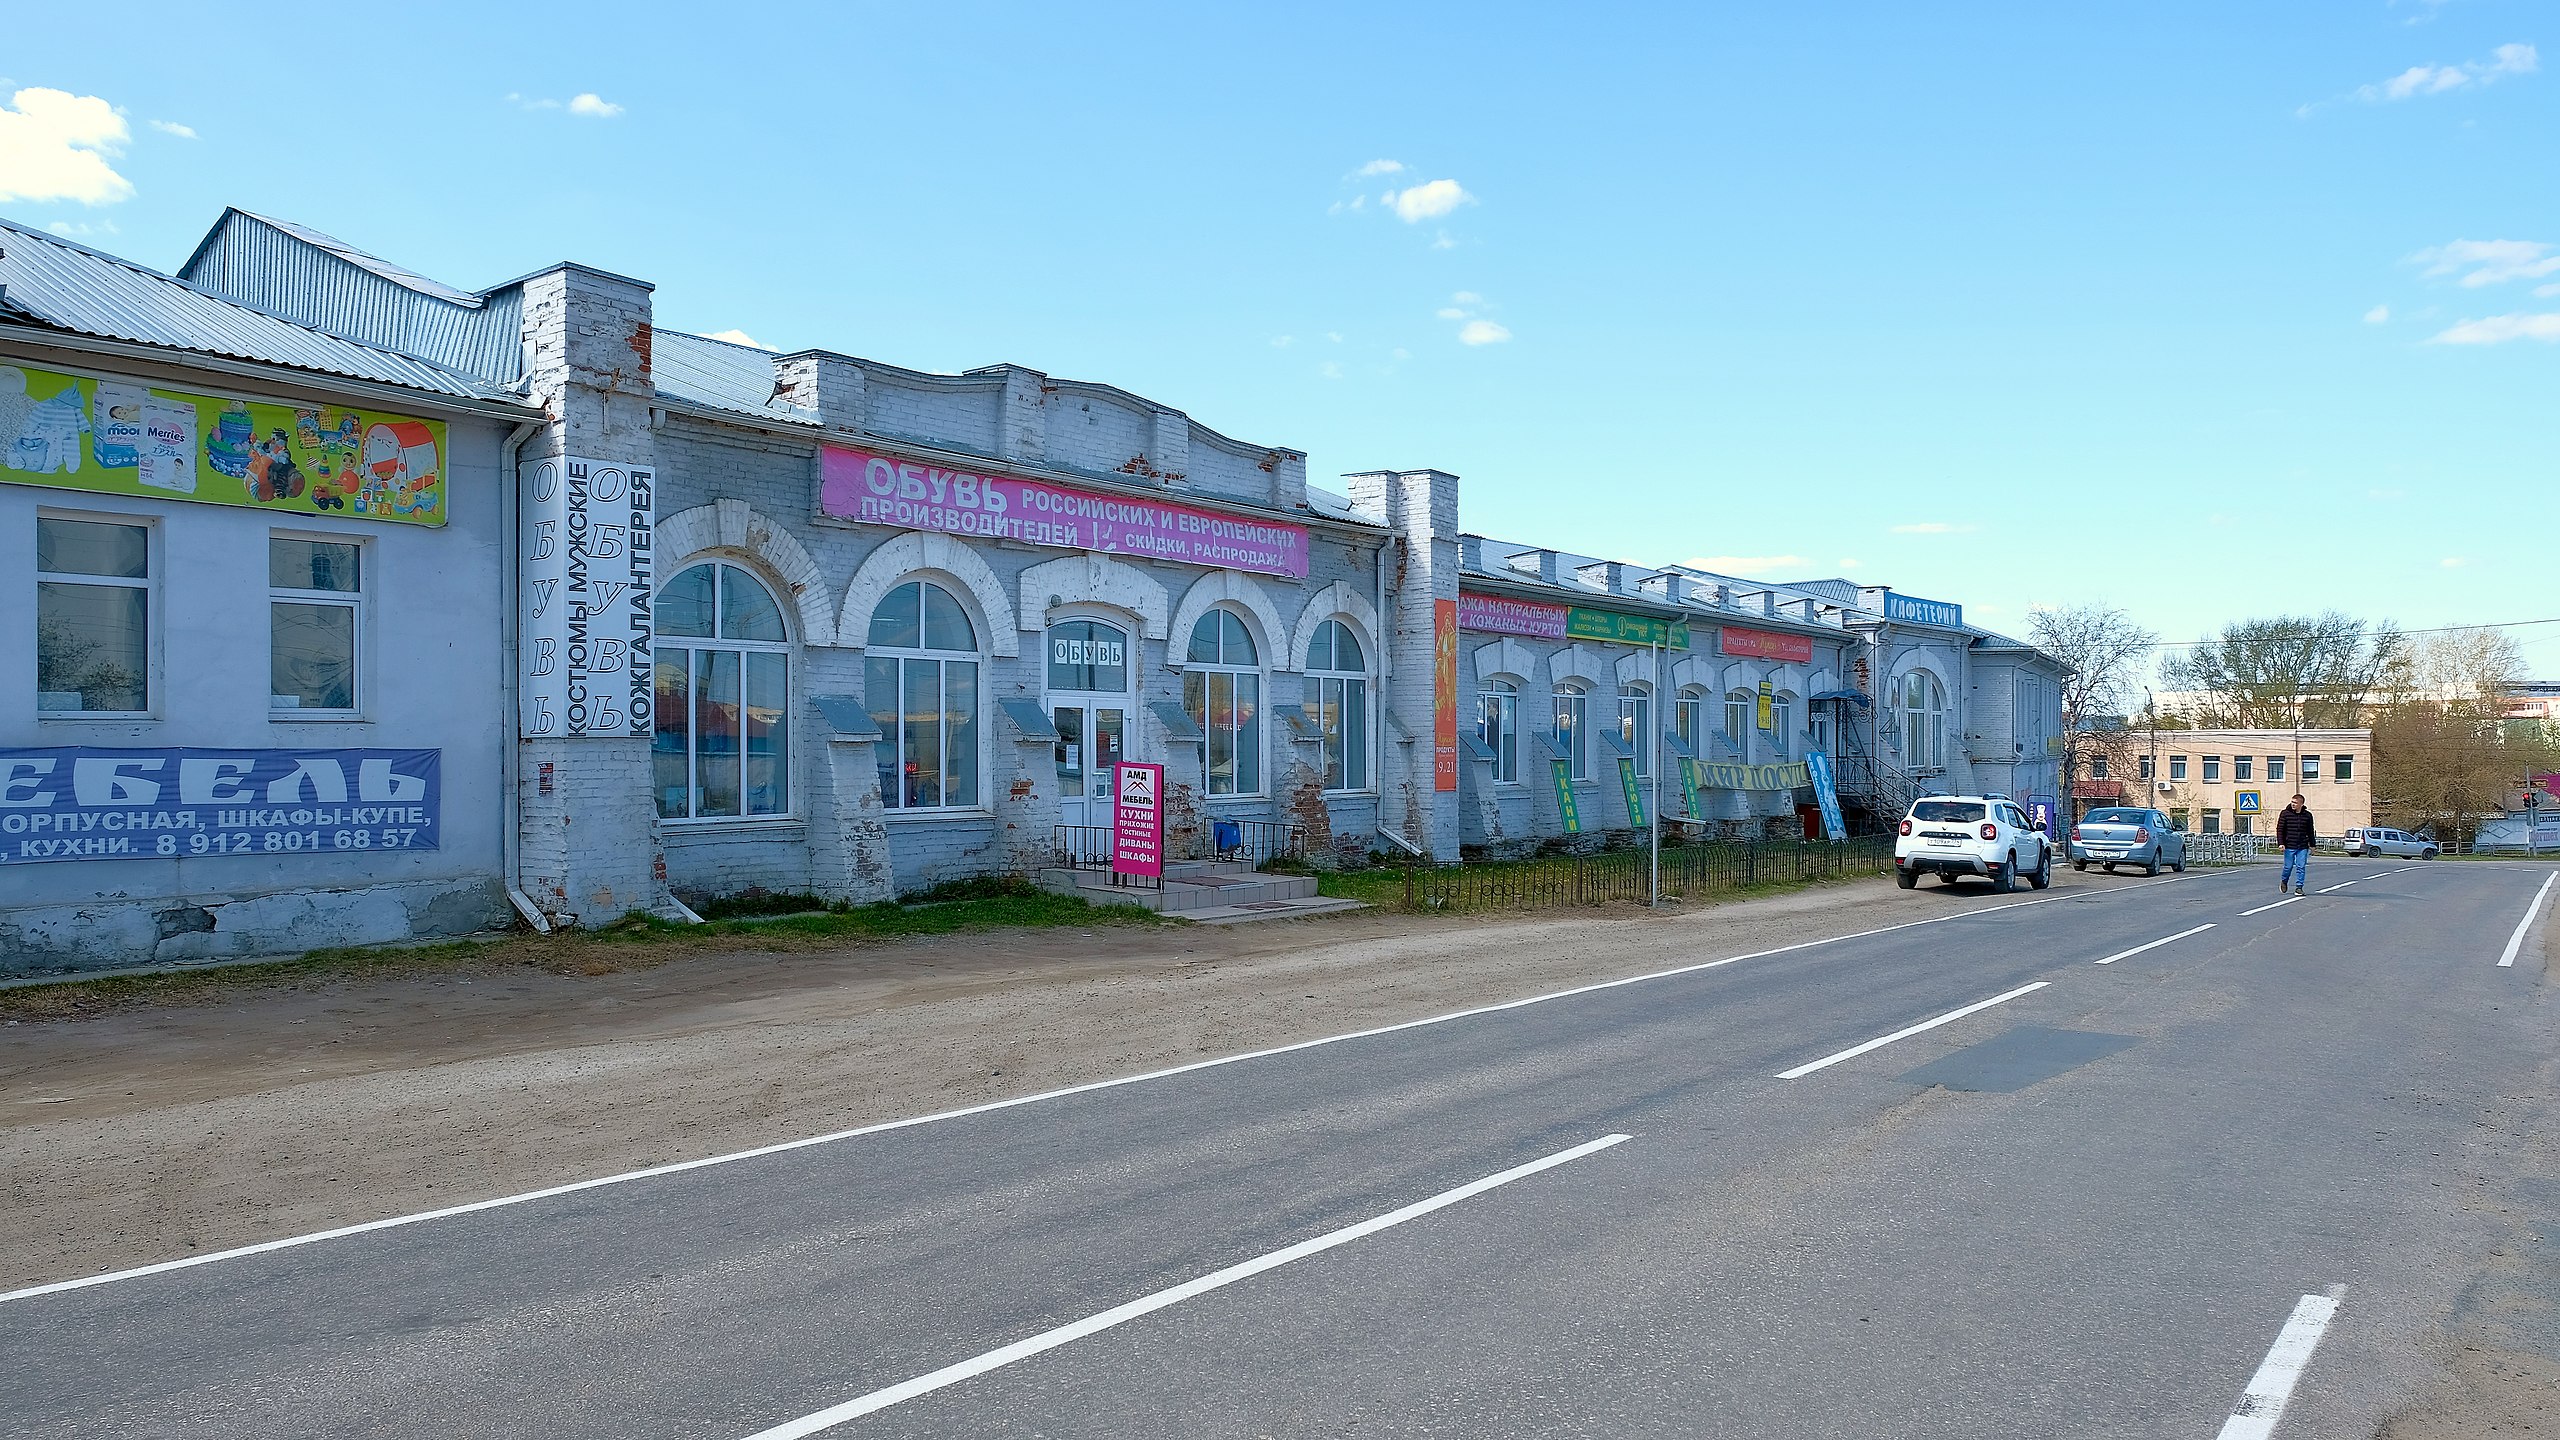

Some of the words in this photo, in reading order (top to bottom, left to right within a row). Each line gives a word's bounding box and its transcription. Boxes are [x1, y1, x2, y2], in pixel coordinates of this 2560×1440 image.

[147, 426, 186, 442] Merries
[864, 457, 1008, 513] ОБУВЬ
[1021, 488, 1156, 528] РОССИЙСКИХ
[1160, 512, 1173, 530] И
[1178, 513, 1297, 549] ЕВРОПЕЙСКИХ
[568, 462, 588, 593] МУЖСКИЕ
[861, 495, 1079, 546] ПРОИЗВОДИТЕЛЕЙ
[1125, 533, 1190, 559] СКИДКИ,
[1194, 542, 1286, 568] РАСПРОДАЖА
[530, 461, 559, 735] ОБУВЬ
[586, 467, 629, 732] ОБУВЬ
[630, 470, 651, 737] КОЖГАЛАНТЕРЕЯ
[1457, 596, 1486, 613] АЖА
[1488, 600, 1566, 622] НАТУРАЛЬНЫХ
[1469, 613, 1527, 633] КОЖАНЫХ
[1528, 620, 1567, 637] КУРТОК
[1889, 598, 1957, 626] КАФЕТЕРИЙ
[1055, 642, 1122, 666] ОБУВЬ
[568, 600, 588, 737] КОСТЮМЫ
[1126, 770, 1148, 781] АМД
[1698, 763, 1745, 788] МИР
[1122, 794, 1154, 805] МЕБЕЛЬ
[1557, 764, 1577, 832] ТКАНИ
[0, 810, 206, 833] ОРПУСНАЯ,
[218, 806, 432, 828] ШКАФЫ-КУПЕ,
[1119, 819, 1155, 829] ПРИХОЖИЕ
[1120, 808, 1154, 821] КУХНИ
[21, 836, 139, 857] КУХНИ.
[156, 834, 177, 855] 8
[189, 832, 252, 855] 912
[264, 830, 320, 851] 801
[333, 829, 371, 850] 68
[381, 828, 417, 848] 57
[1119, 837, 1155, 850] ДИВАНЫ
[1121, 828, 1151, 838] ГОСТИНЫЕ
[1119, 850, 1155, 863] ШКАФЫ
